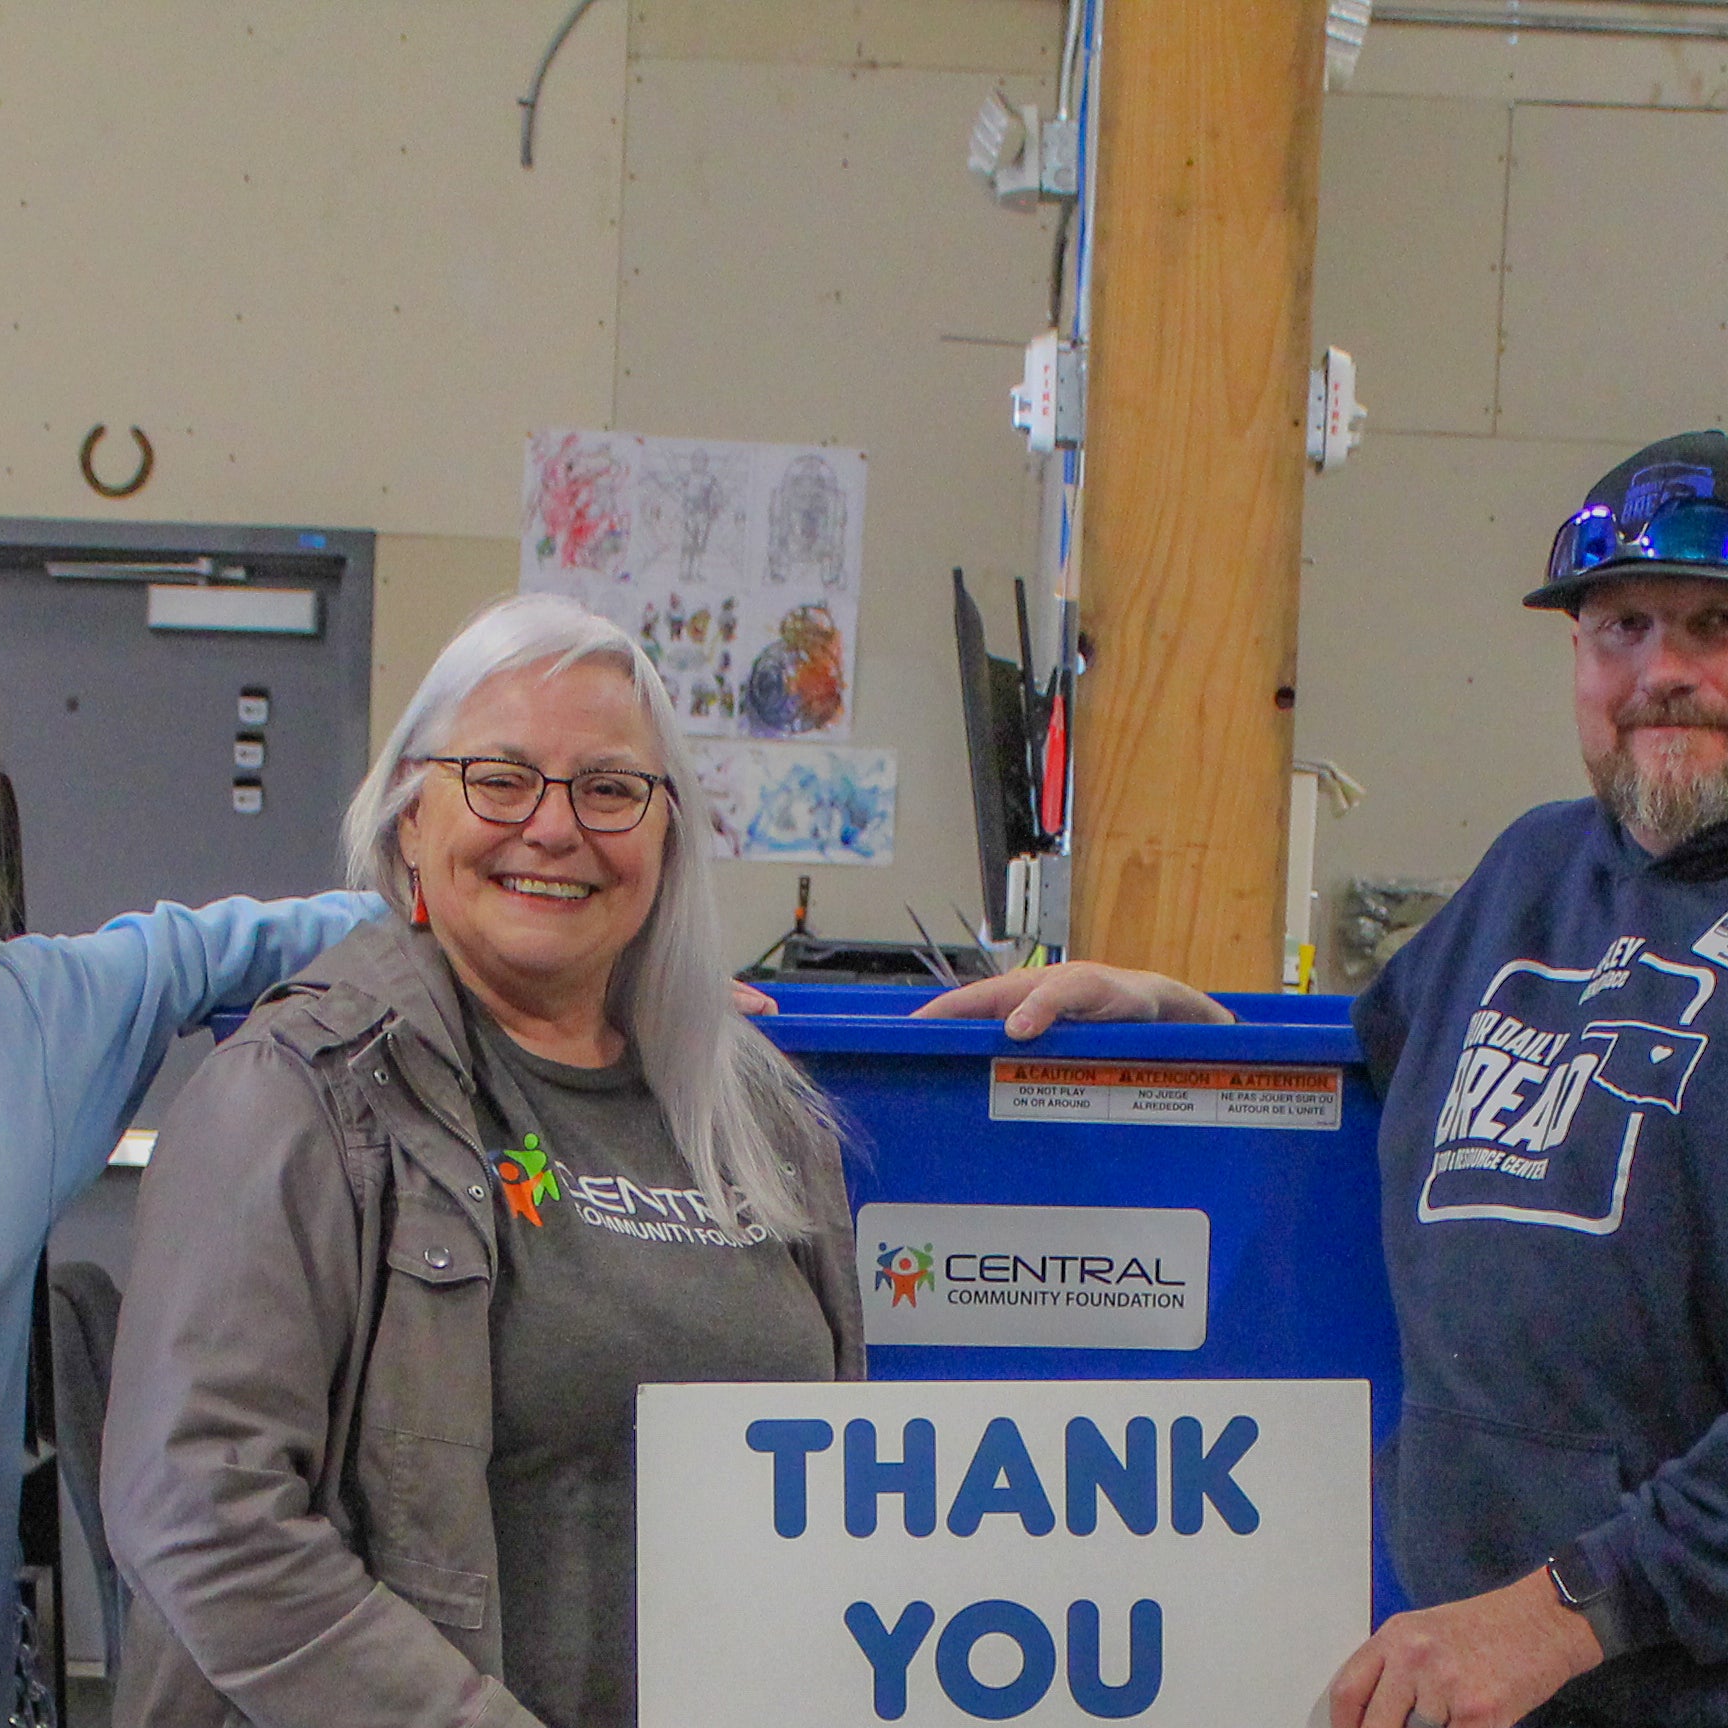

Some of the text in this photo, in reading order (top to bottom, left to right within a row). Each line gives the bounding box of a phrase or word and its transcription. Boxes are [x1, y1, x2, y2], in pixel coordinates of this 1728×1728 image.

[1487, 1015, 1571, 1067] DAILY
[1029, 1066, 1097, 1081] CAUTION
[1245, 1073, 1329, 1088] ATTENTION
[1018, 1086, 1086, 1096] DO NOT PLAY
[1138, 1090, 1153, 1099] NO
[1221, 1092, 1236, 1101] NE
[1238, 1093, 1257, 1102] PAS
[1259, 1093, 1293, 1103] JOUER
[1433, 1045, 1600, 1152] BREAD
[1013, 1098, 1091, 1109] ON OR AROUND
[1132, 1102, 1194, 1112] ALREDEDOR
[1227, 1104, 1270, 1114] AUTOUR
[1272, 1105, 1286, 1114] DE
[944, 1253, 1187, 1288] CENTRAL
[947, 1288, 1186, 1310] COMMUNITY FOUNDATION
[744, 1414, 1261, 1540] THANK
[843, 1597, 1165, 1722] YOU
